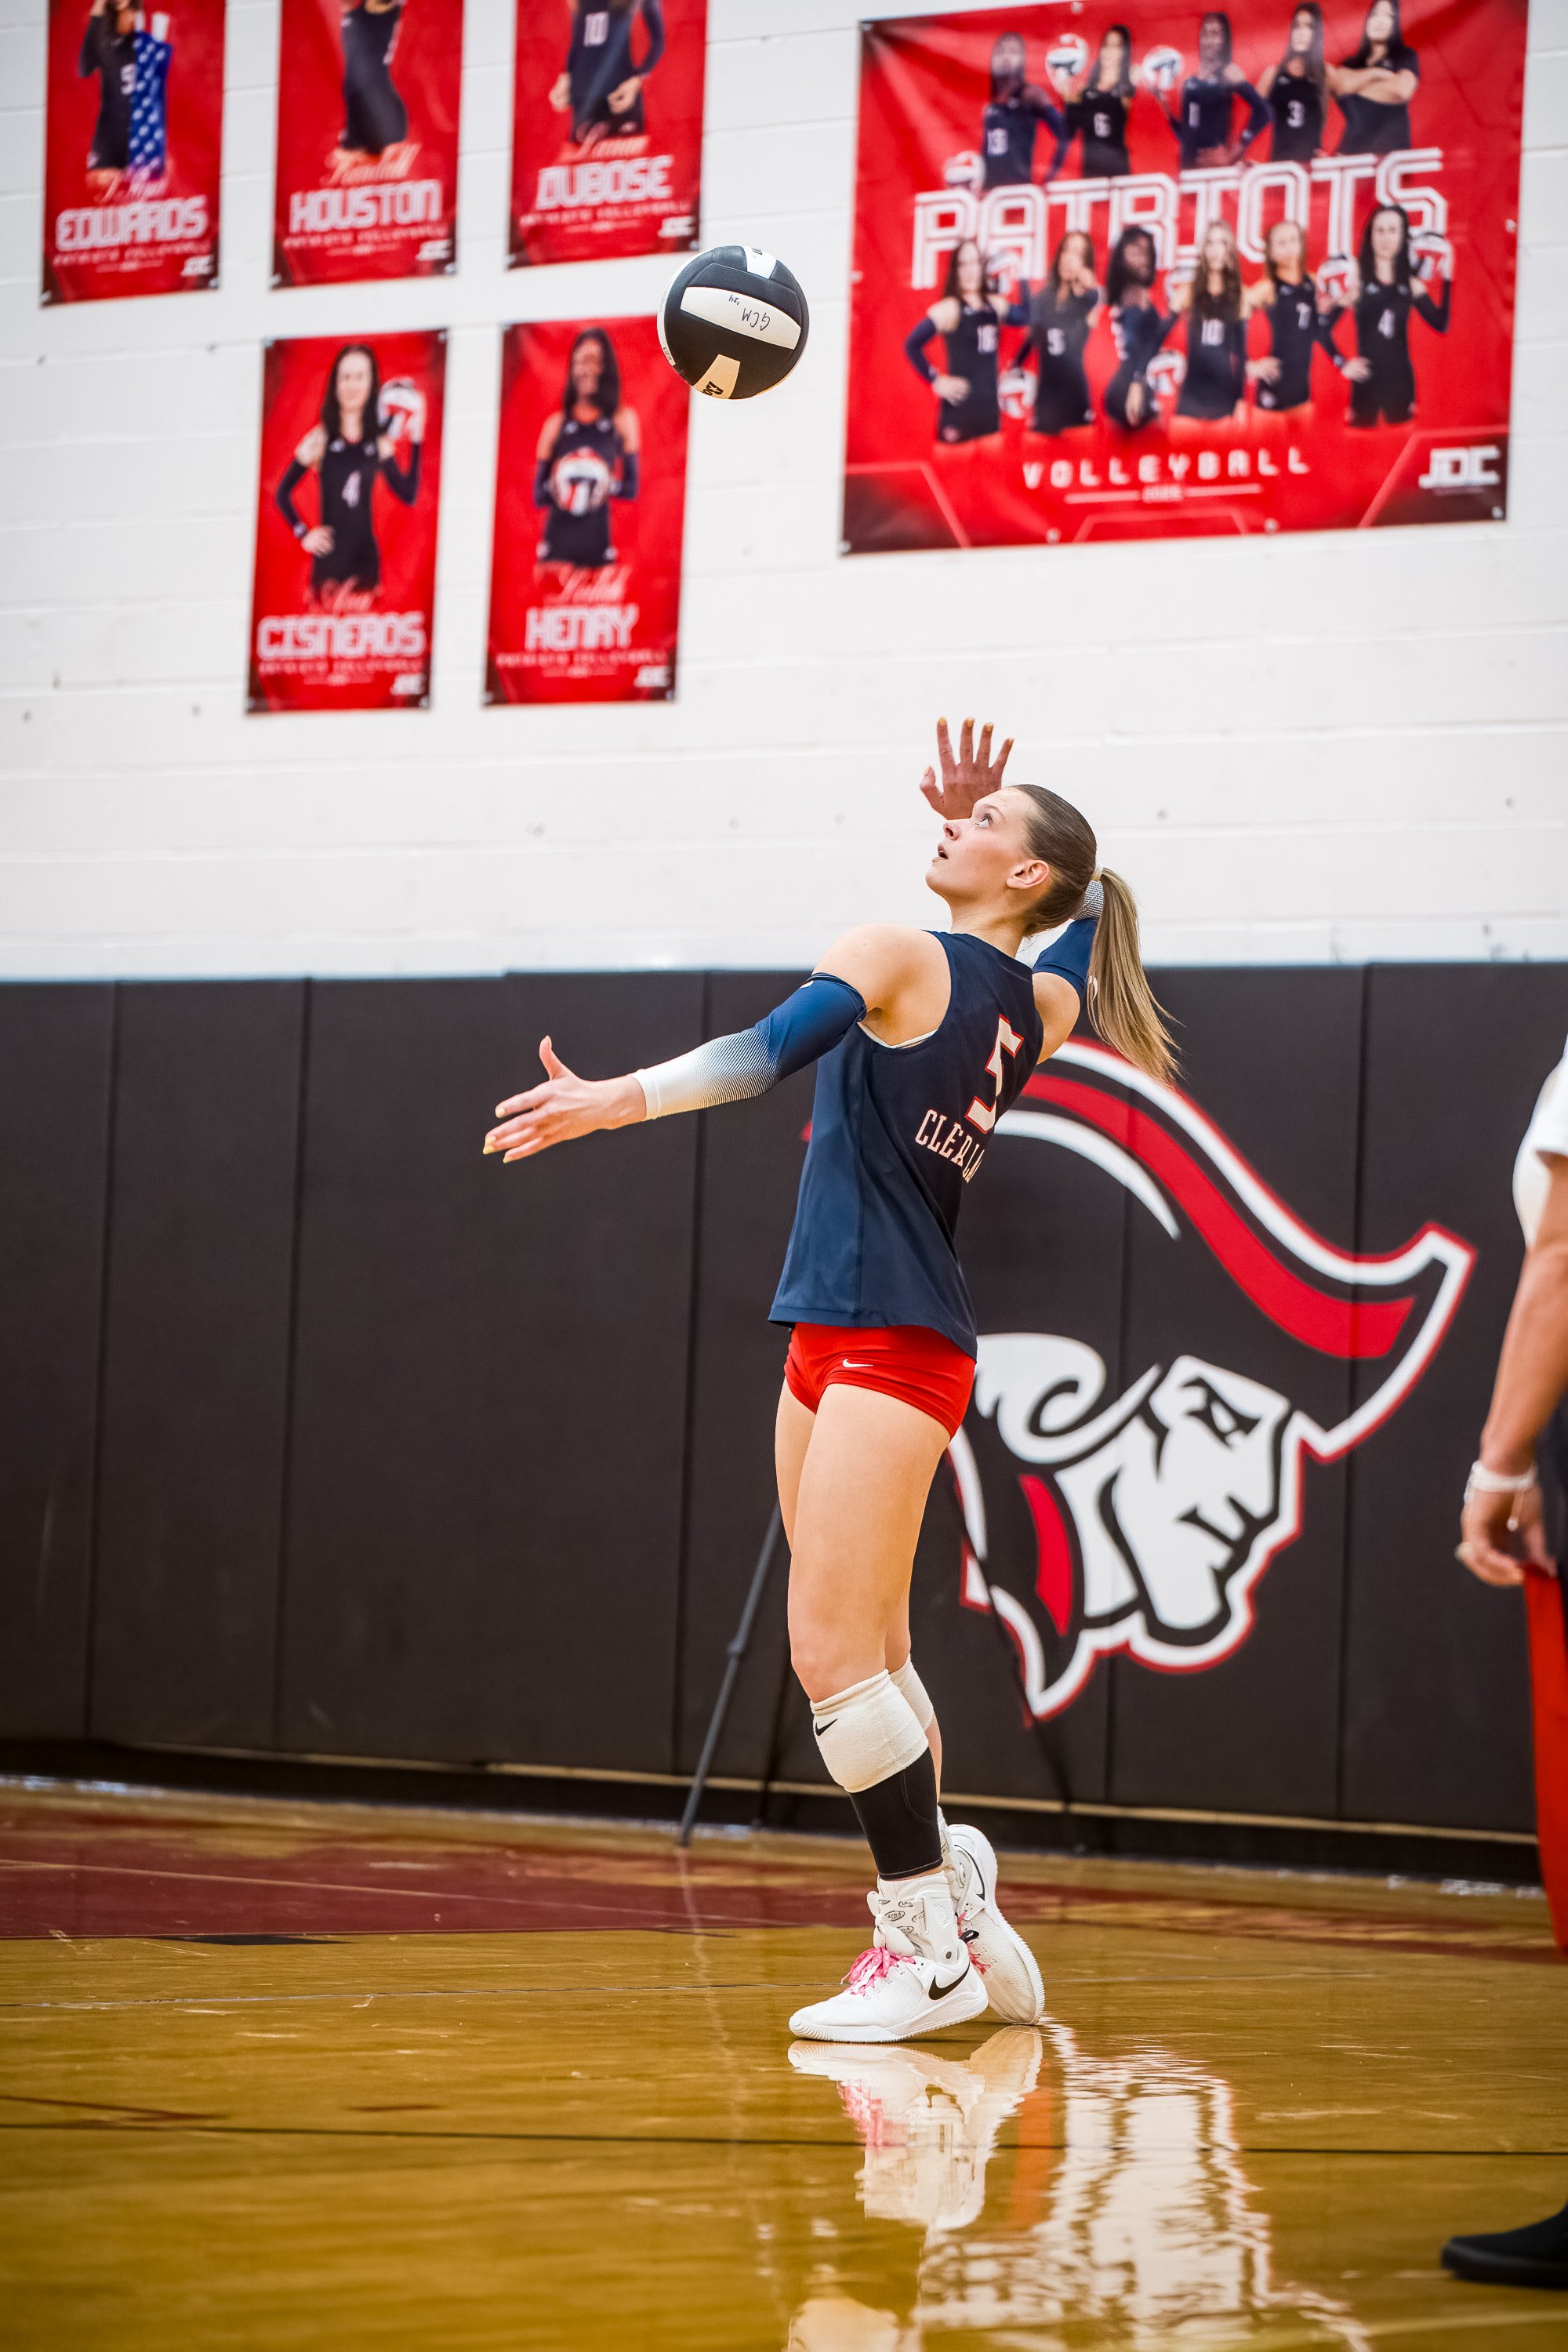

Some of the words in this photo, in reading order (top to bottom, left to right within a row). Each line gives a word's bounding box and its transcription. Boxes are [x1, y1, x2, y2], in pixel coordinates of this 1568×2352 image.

[289, 179, 443, 234] HOUSTON
[535, 154, 673, 211] DUBOSE
[56, 194, 209, 252] EDWARDS
[912, 147, 1447, 289] PATRIOTS
[742, 307, 771, 331] GCM
[1022, 446, 1311, 489] VOLLEYBALL
[257, 610, 426, 661] CISNEROS
[524, 603, 640, 652] HENRY
[964, 1014, 1024, 1134] 5
